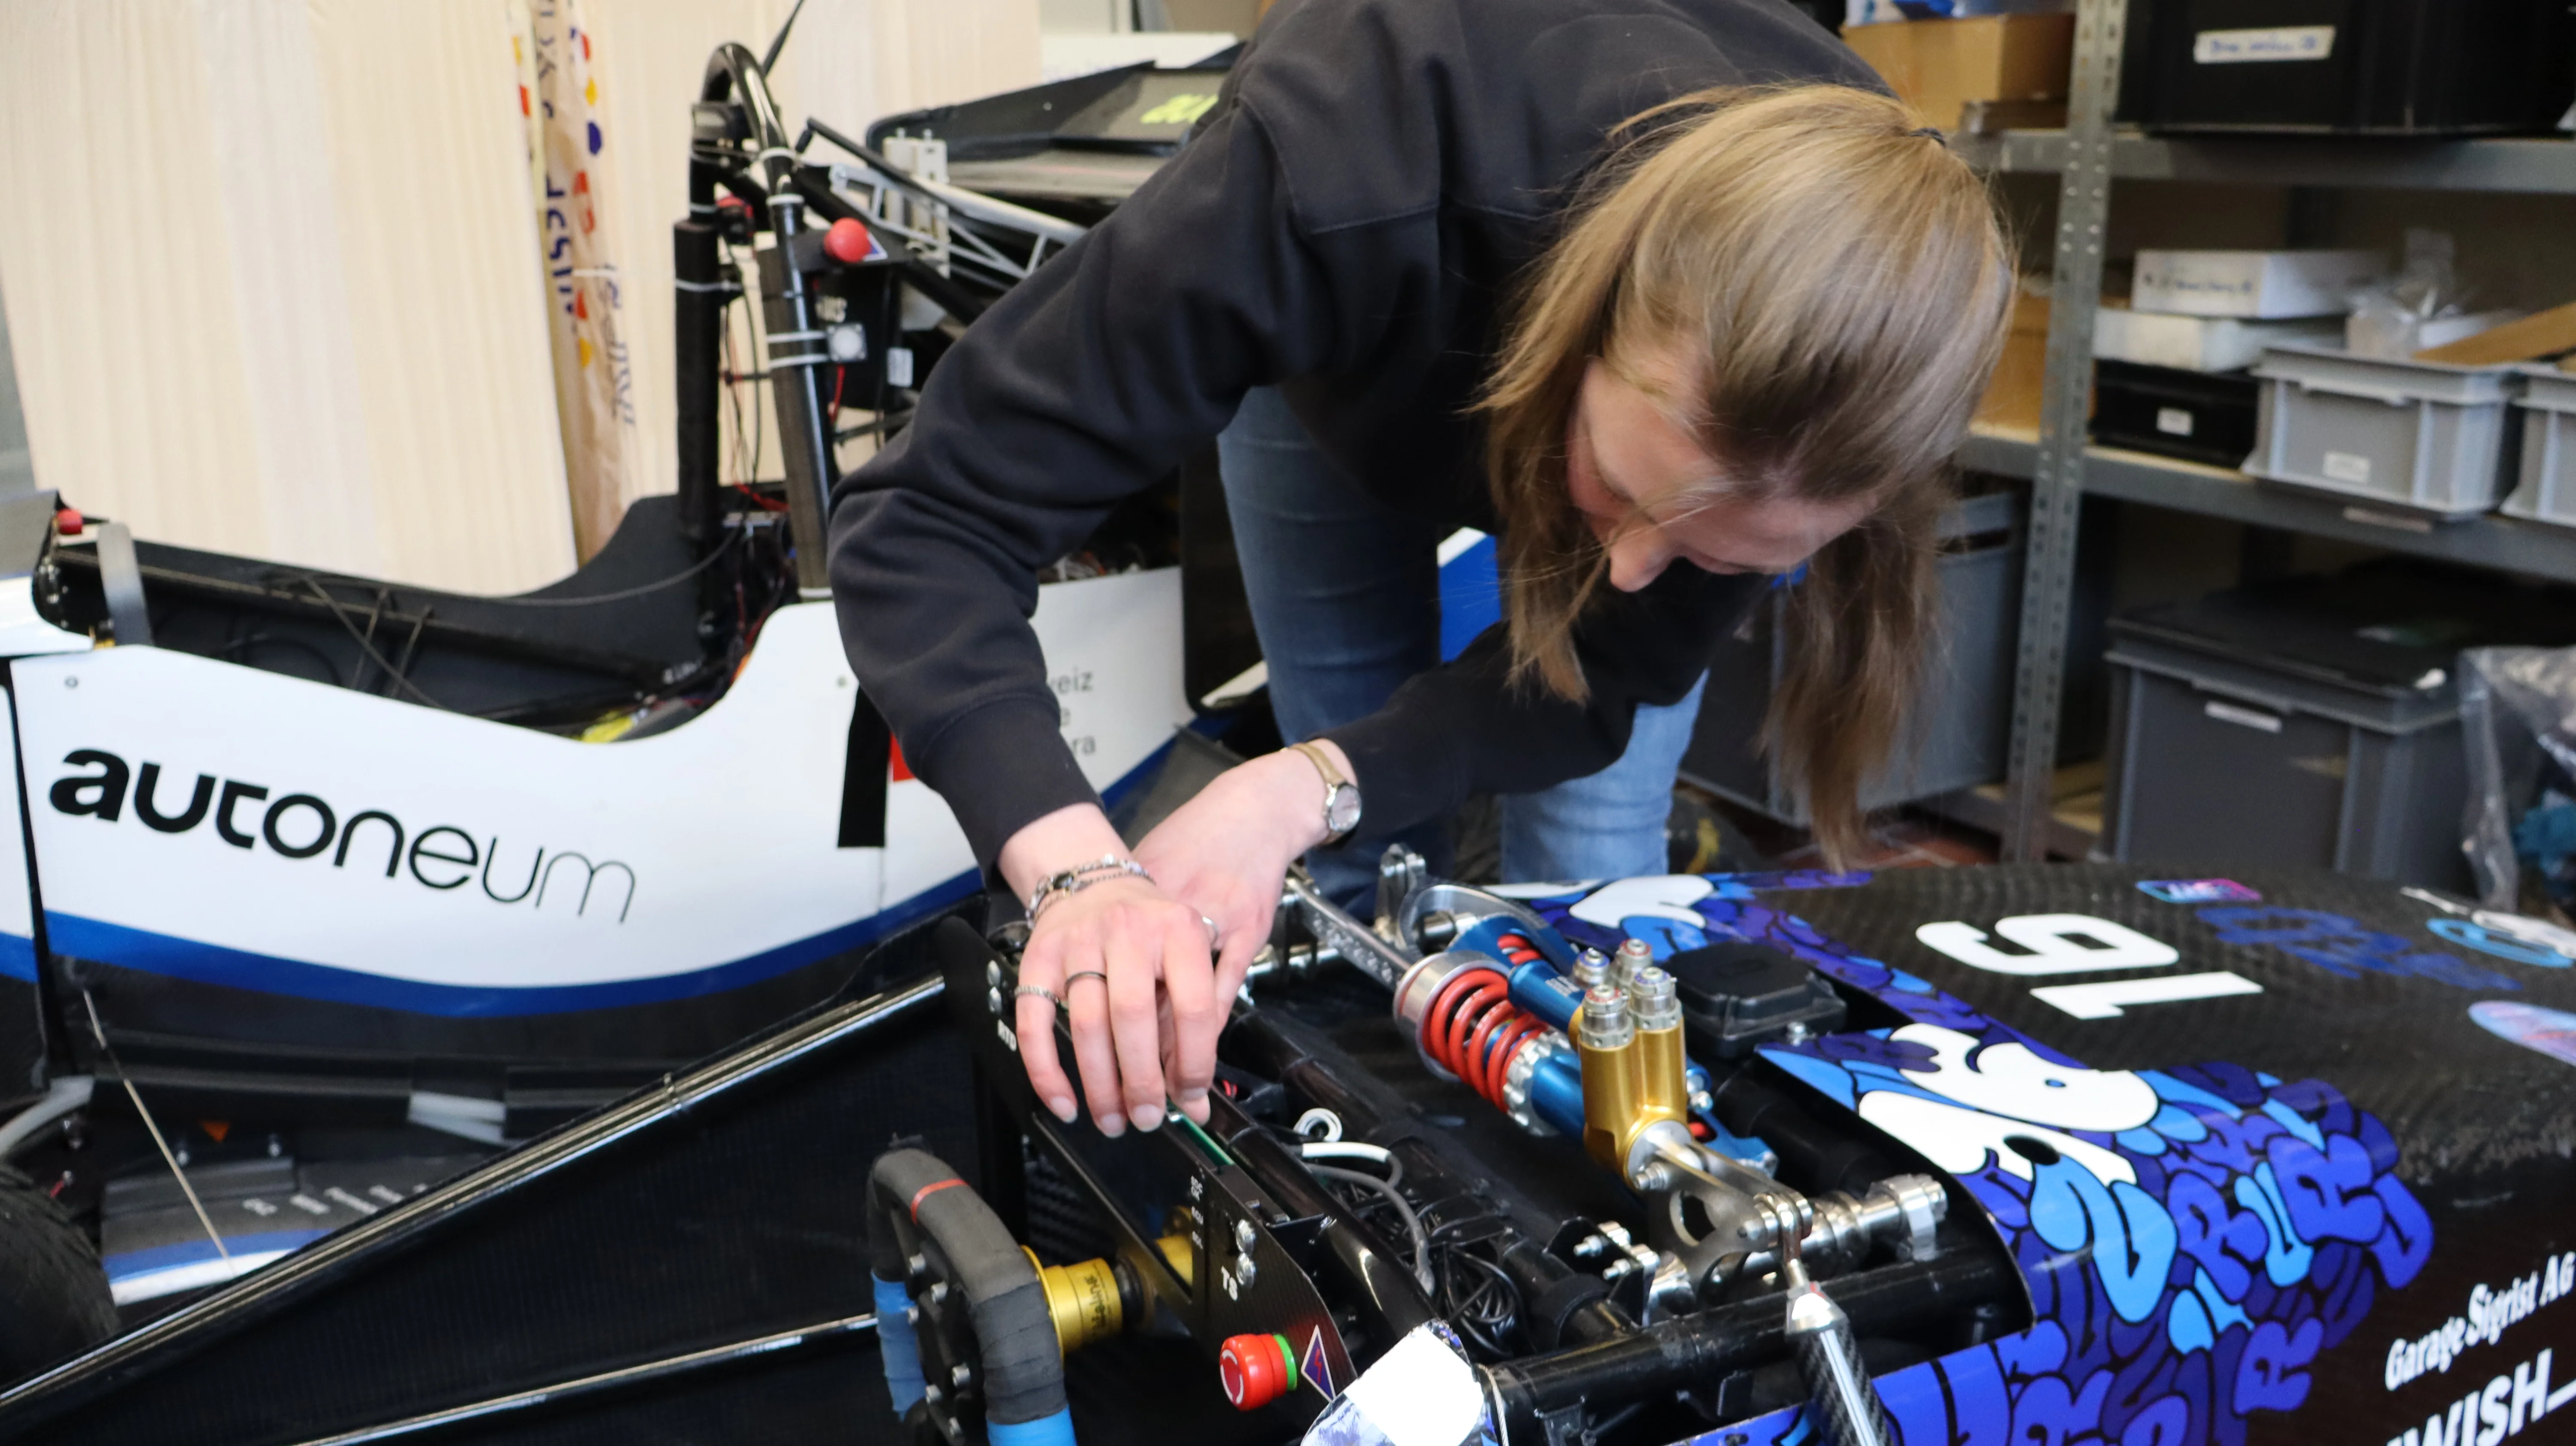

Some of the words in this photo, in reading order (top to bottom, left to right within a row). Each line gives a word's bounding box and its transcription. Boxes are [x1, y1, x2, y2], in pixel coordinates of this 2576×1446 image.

[49, 748, 636, 923] autoneum
[1221, 1265, 1238, 1301] TS
[2385, 1315, 2467, 1391] Garage
[2464, 1270, 2539, 1346] Sigrist
[2539, 1251, 2576, 1307] AG
